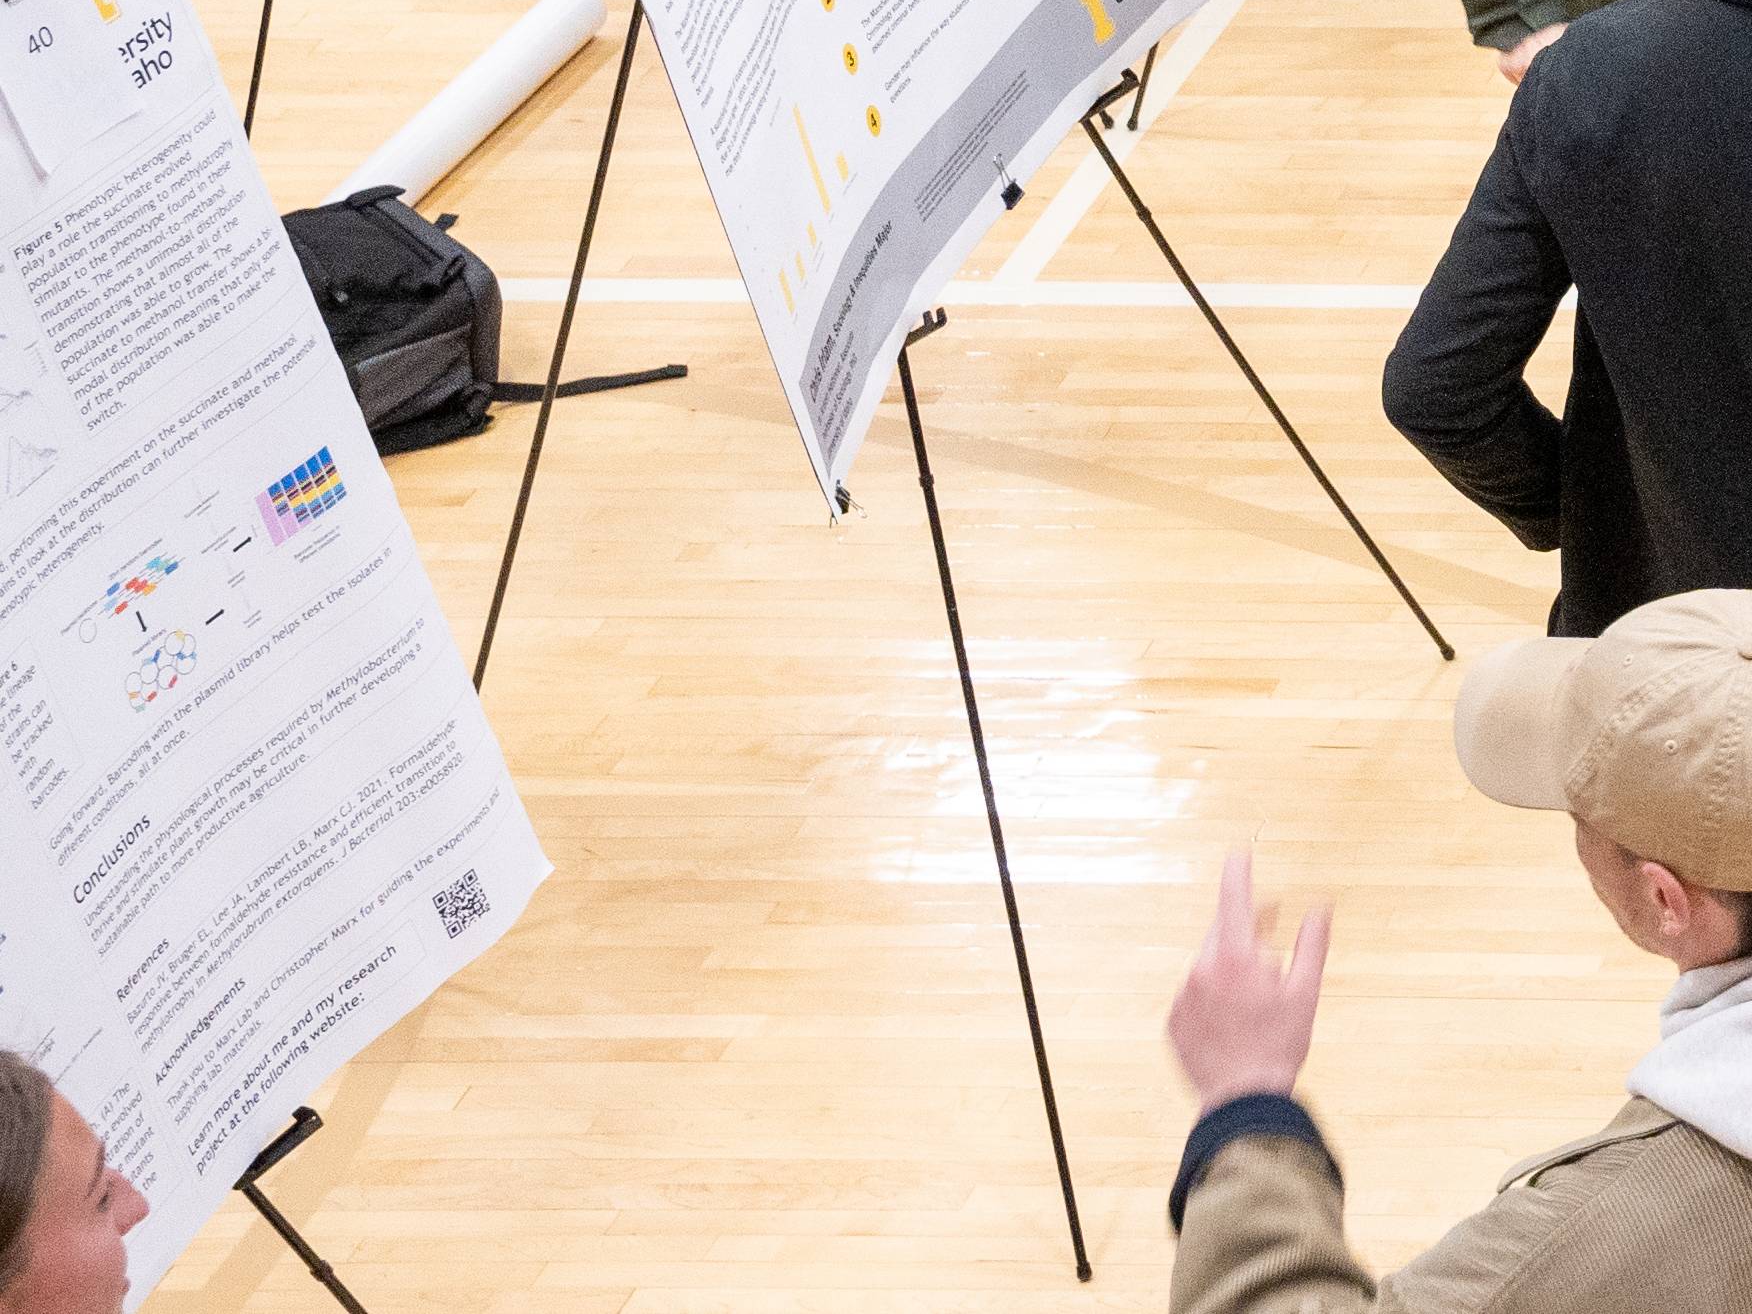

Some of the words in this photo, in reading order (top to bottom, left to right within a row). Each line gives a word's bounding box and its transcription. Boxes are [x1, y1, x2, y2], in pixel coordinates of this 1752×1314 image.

[27, 27, 55, 55] 40
[846, 51, 855, 67] 3
[870, 113, 878, 128] 4
[72, 814, 150, 904] Conclusions
[187, 1120, 213, 1156] Learn
[212, 1088, 241, 1122] more
[242, 1053, 271, 1090] about
[271, 1034, 288, 1056] me
[290, 1008, 314, 1037] and
[314, 991, 334, 1014] my
[337, 945, 397, 995] research
[195, 1127, 228, 1176] project
[228, 1112, 241, 1130] at
[240, 1091, 260, 1115] the
[259, 1038, 309, 1094] following
[308, 991, 365, 1041] website:
